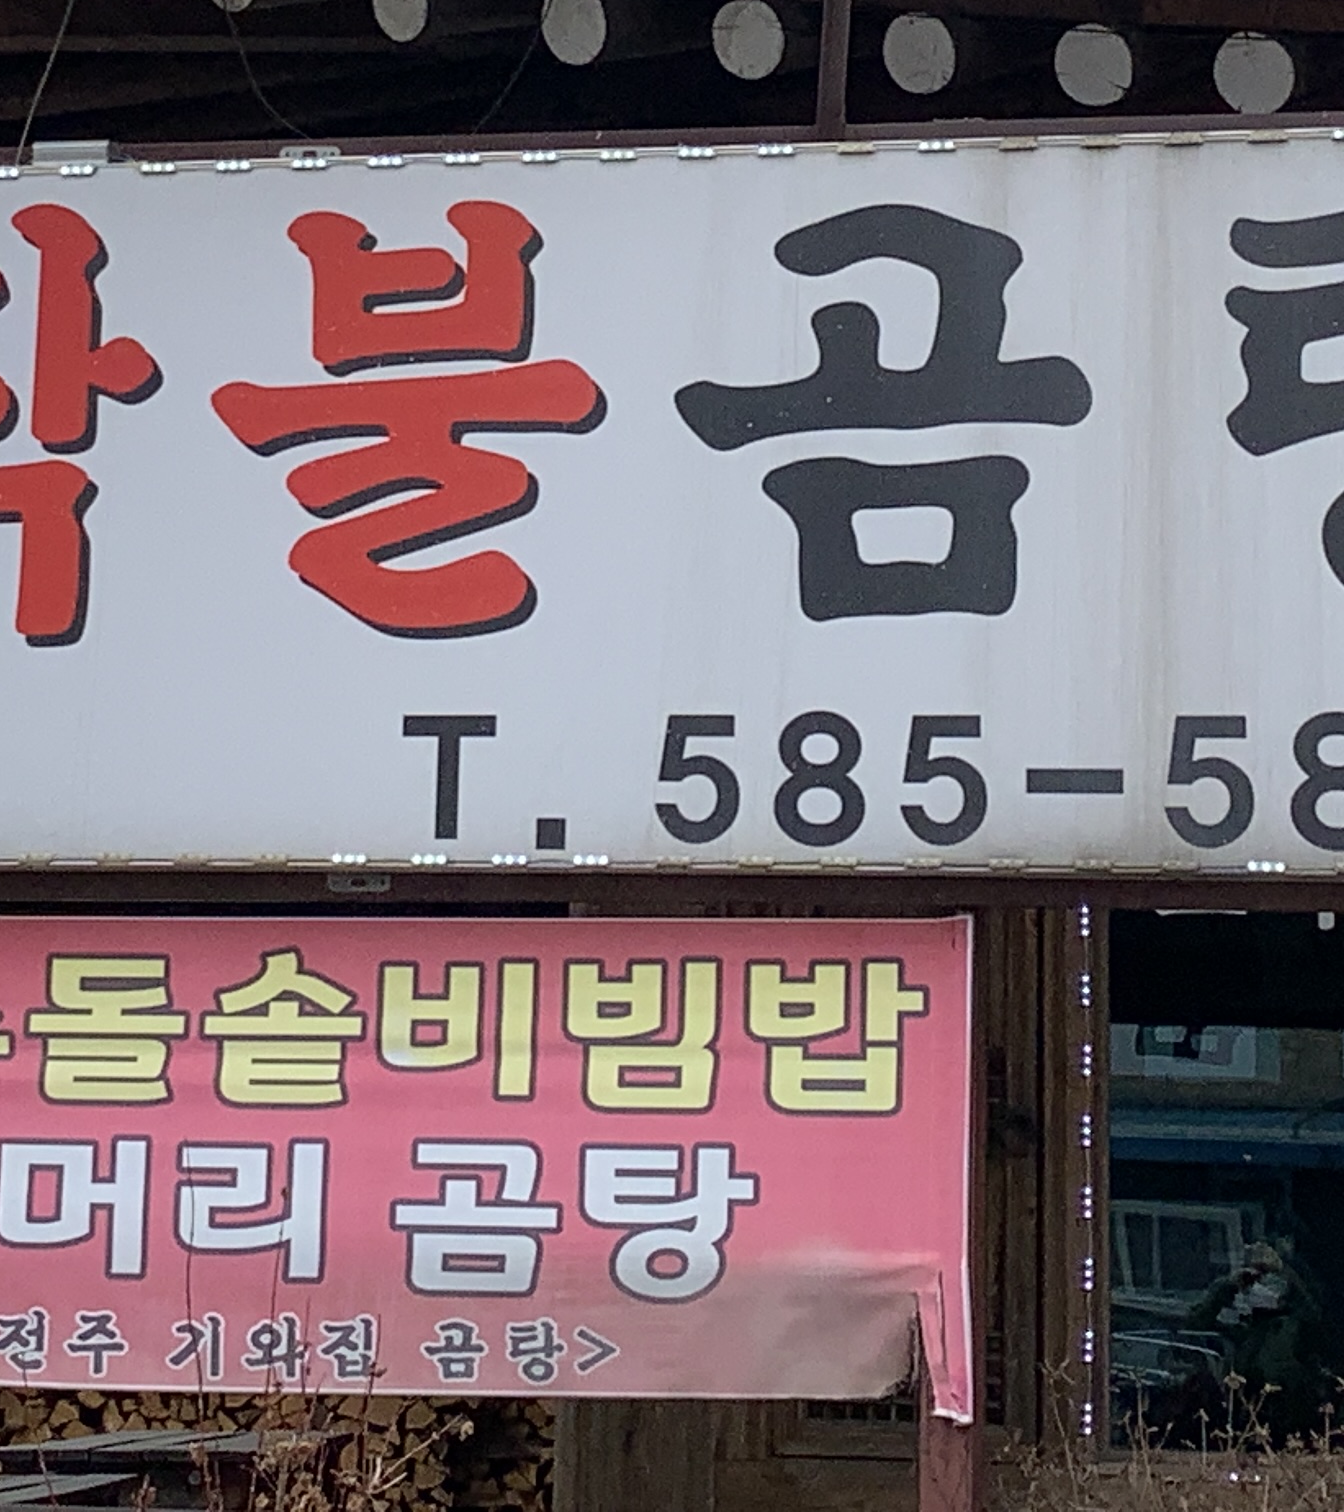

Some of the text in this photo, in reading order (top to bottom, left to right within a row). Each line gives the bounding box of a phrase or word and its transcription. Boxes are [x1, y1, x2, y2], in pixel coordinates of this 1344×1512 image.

[403, 714, 567, 851] T.
[390, 1138, 760, 1303] 곰탕
[166, 1312, 381, 1382] 기와집
